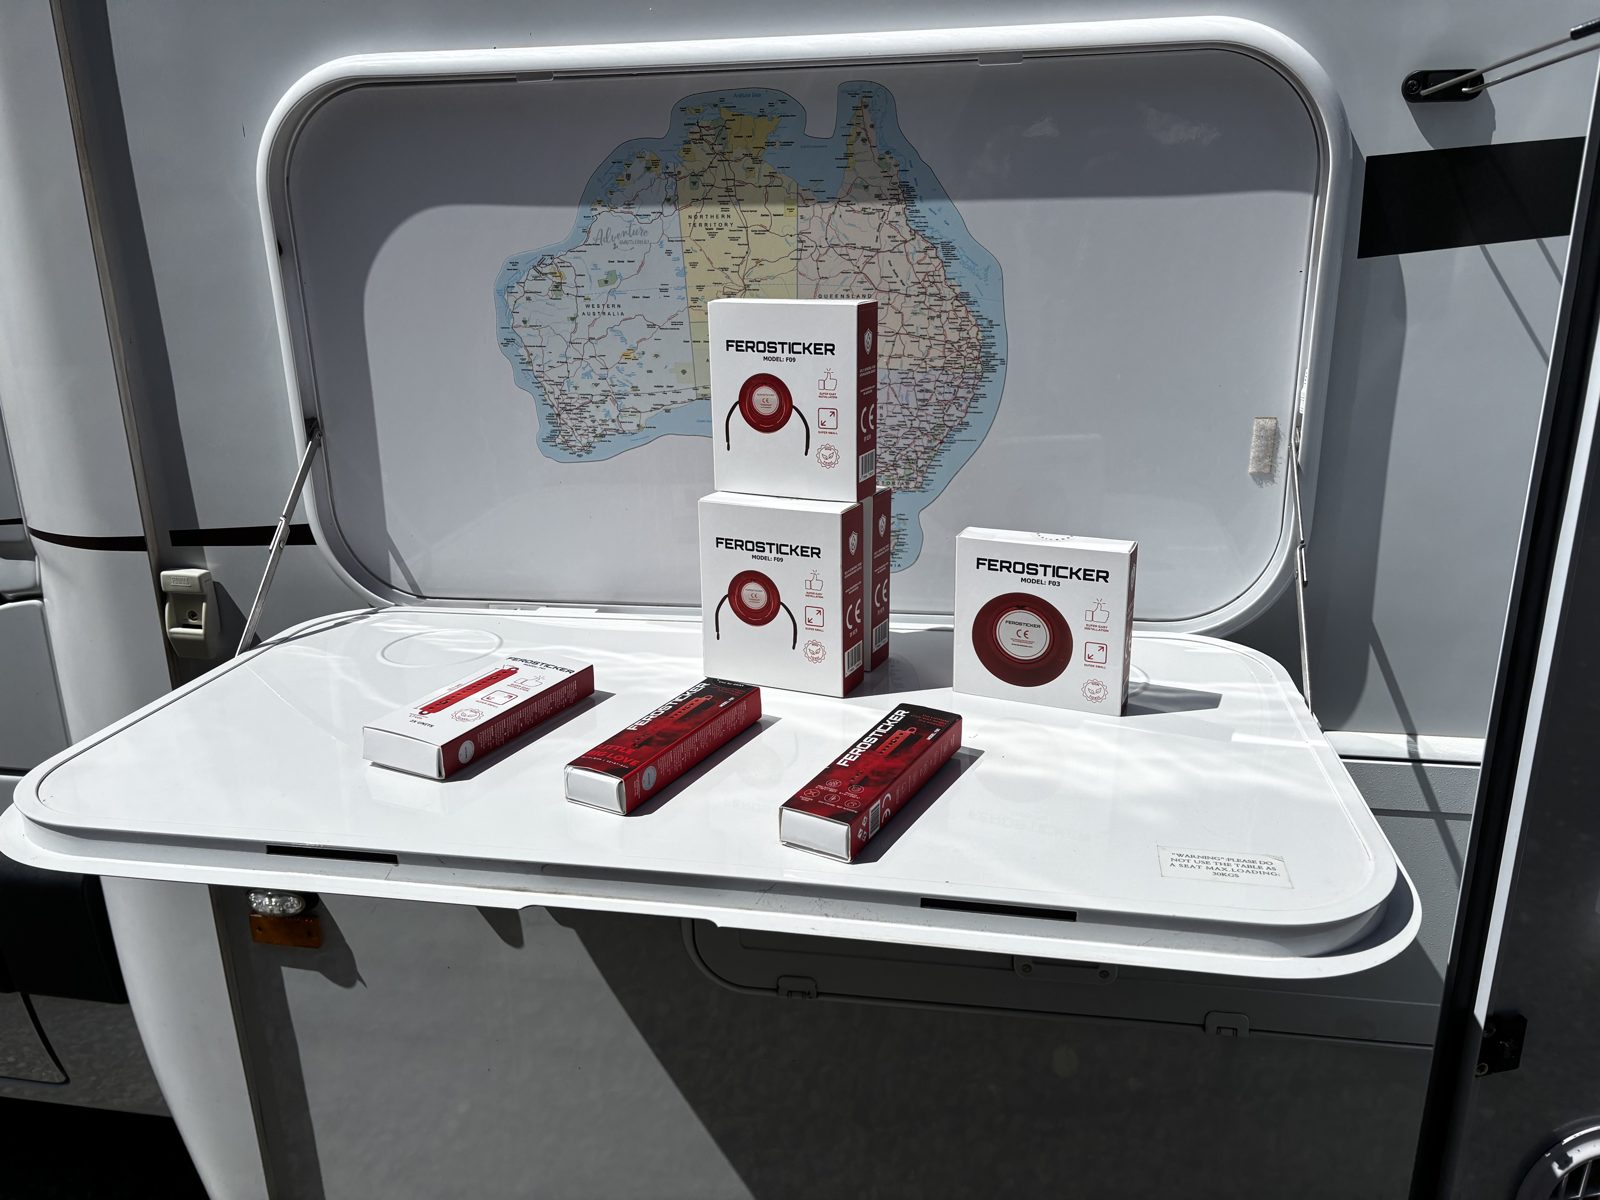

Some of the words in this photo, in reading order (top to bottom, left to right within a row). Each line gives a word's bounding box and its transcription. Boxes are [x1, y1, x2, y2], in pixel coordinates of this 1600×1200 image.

[725, 339, 836, 356] FEROSTICKER
[763, 355, 785, 363] MODEL:
[715, 537, 822, 559] FEROSTICKER
[751, 554, 773, 562] MODEL:
[976, 557, 1110, 583] FEROSTICKER
[1020, 577, 1047, 586] MODEL:
[1004, 620, 1042, 629] FEROSTICKER
[506, 656, 575, 674] FEROSTICKER
[626, 682, 712, 731] FEROSTICKER
[836, 709, 910, 767] FEROSTICKER
[607, 753, 641, 766] LOVE
